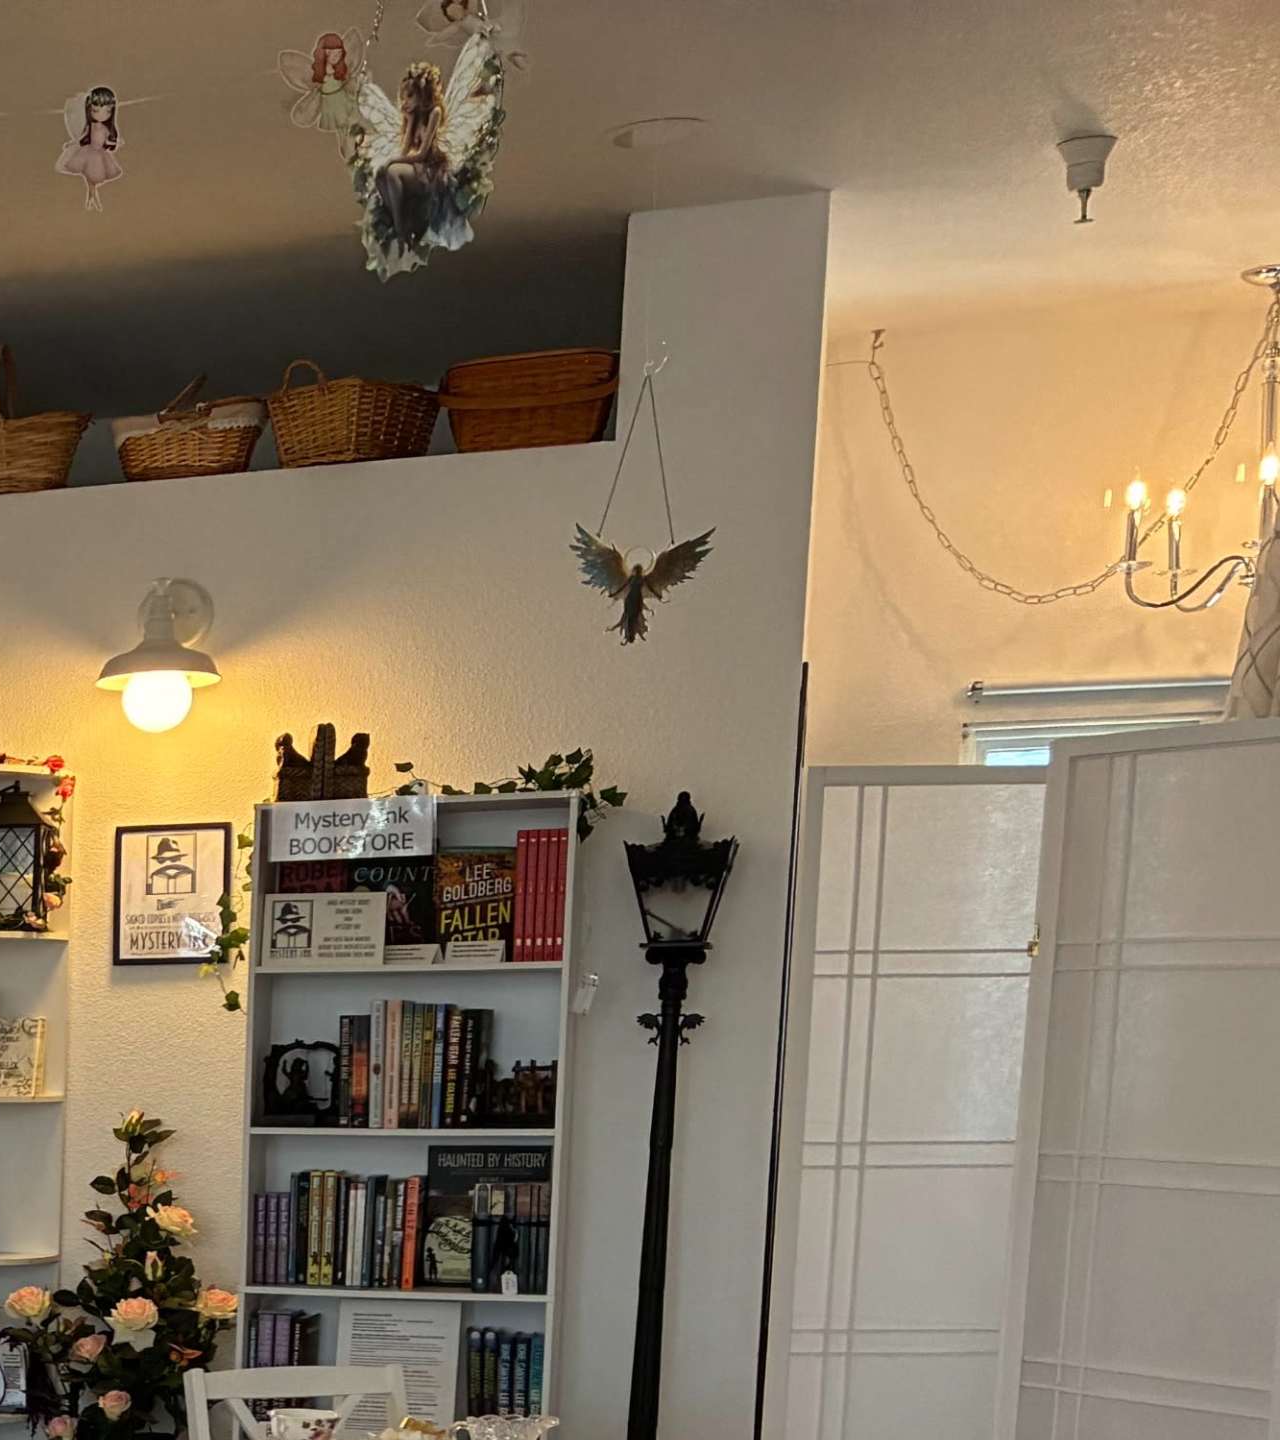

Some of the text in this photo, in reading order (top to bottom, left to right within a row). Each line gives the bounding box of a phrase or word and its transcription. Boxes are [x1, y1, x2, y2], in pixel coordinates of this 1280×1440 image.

[294, 812, 369, 832] Mystery
[354, 866, 435, 883] COUNT
[465, 863, 492, 881] LEE
[443, 876, 513, 902] GOLDBERG
[440, 900, 512, 934] FALLEN
[130, 930, 183, 950] MYSTERY
[438, 1152, 546, 1168] HAUNTED BY HISTORY
